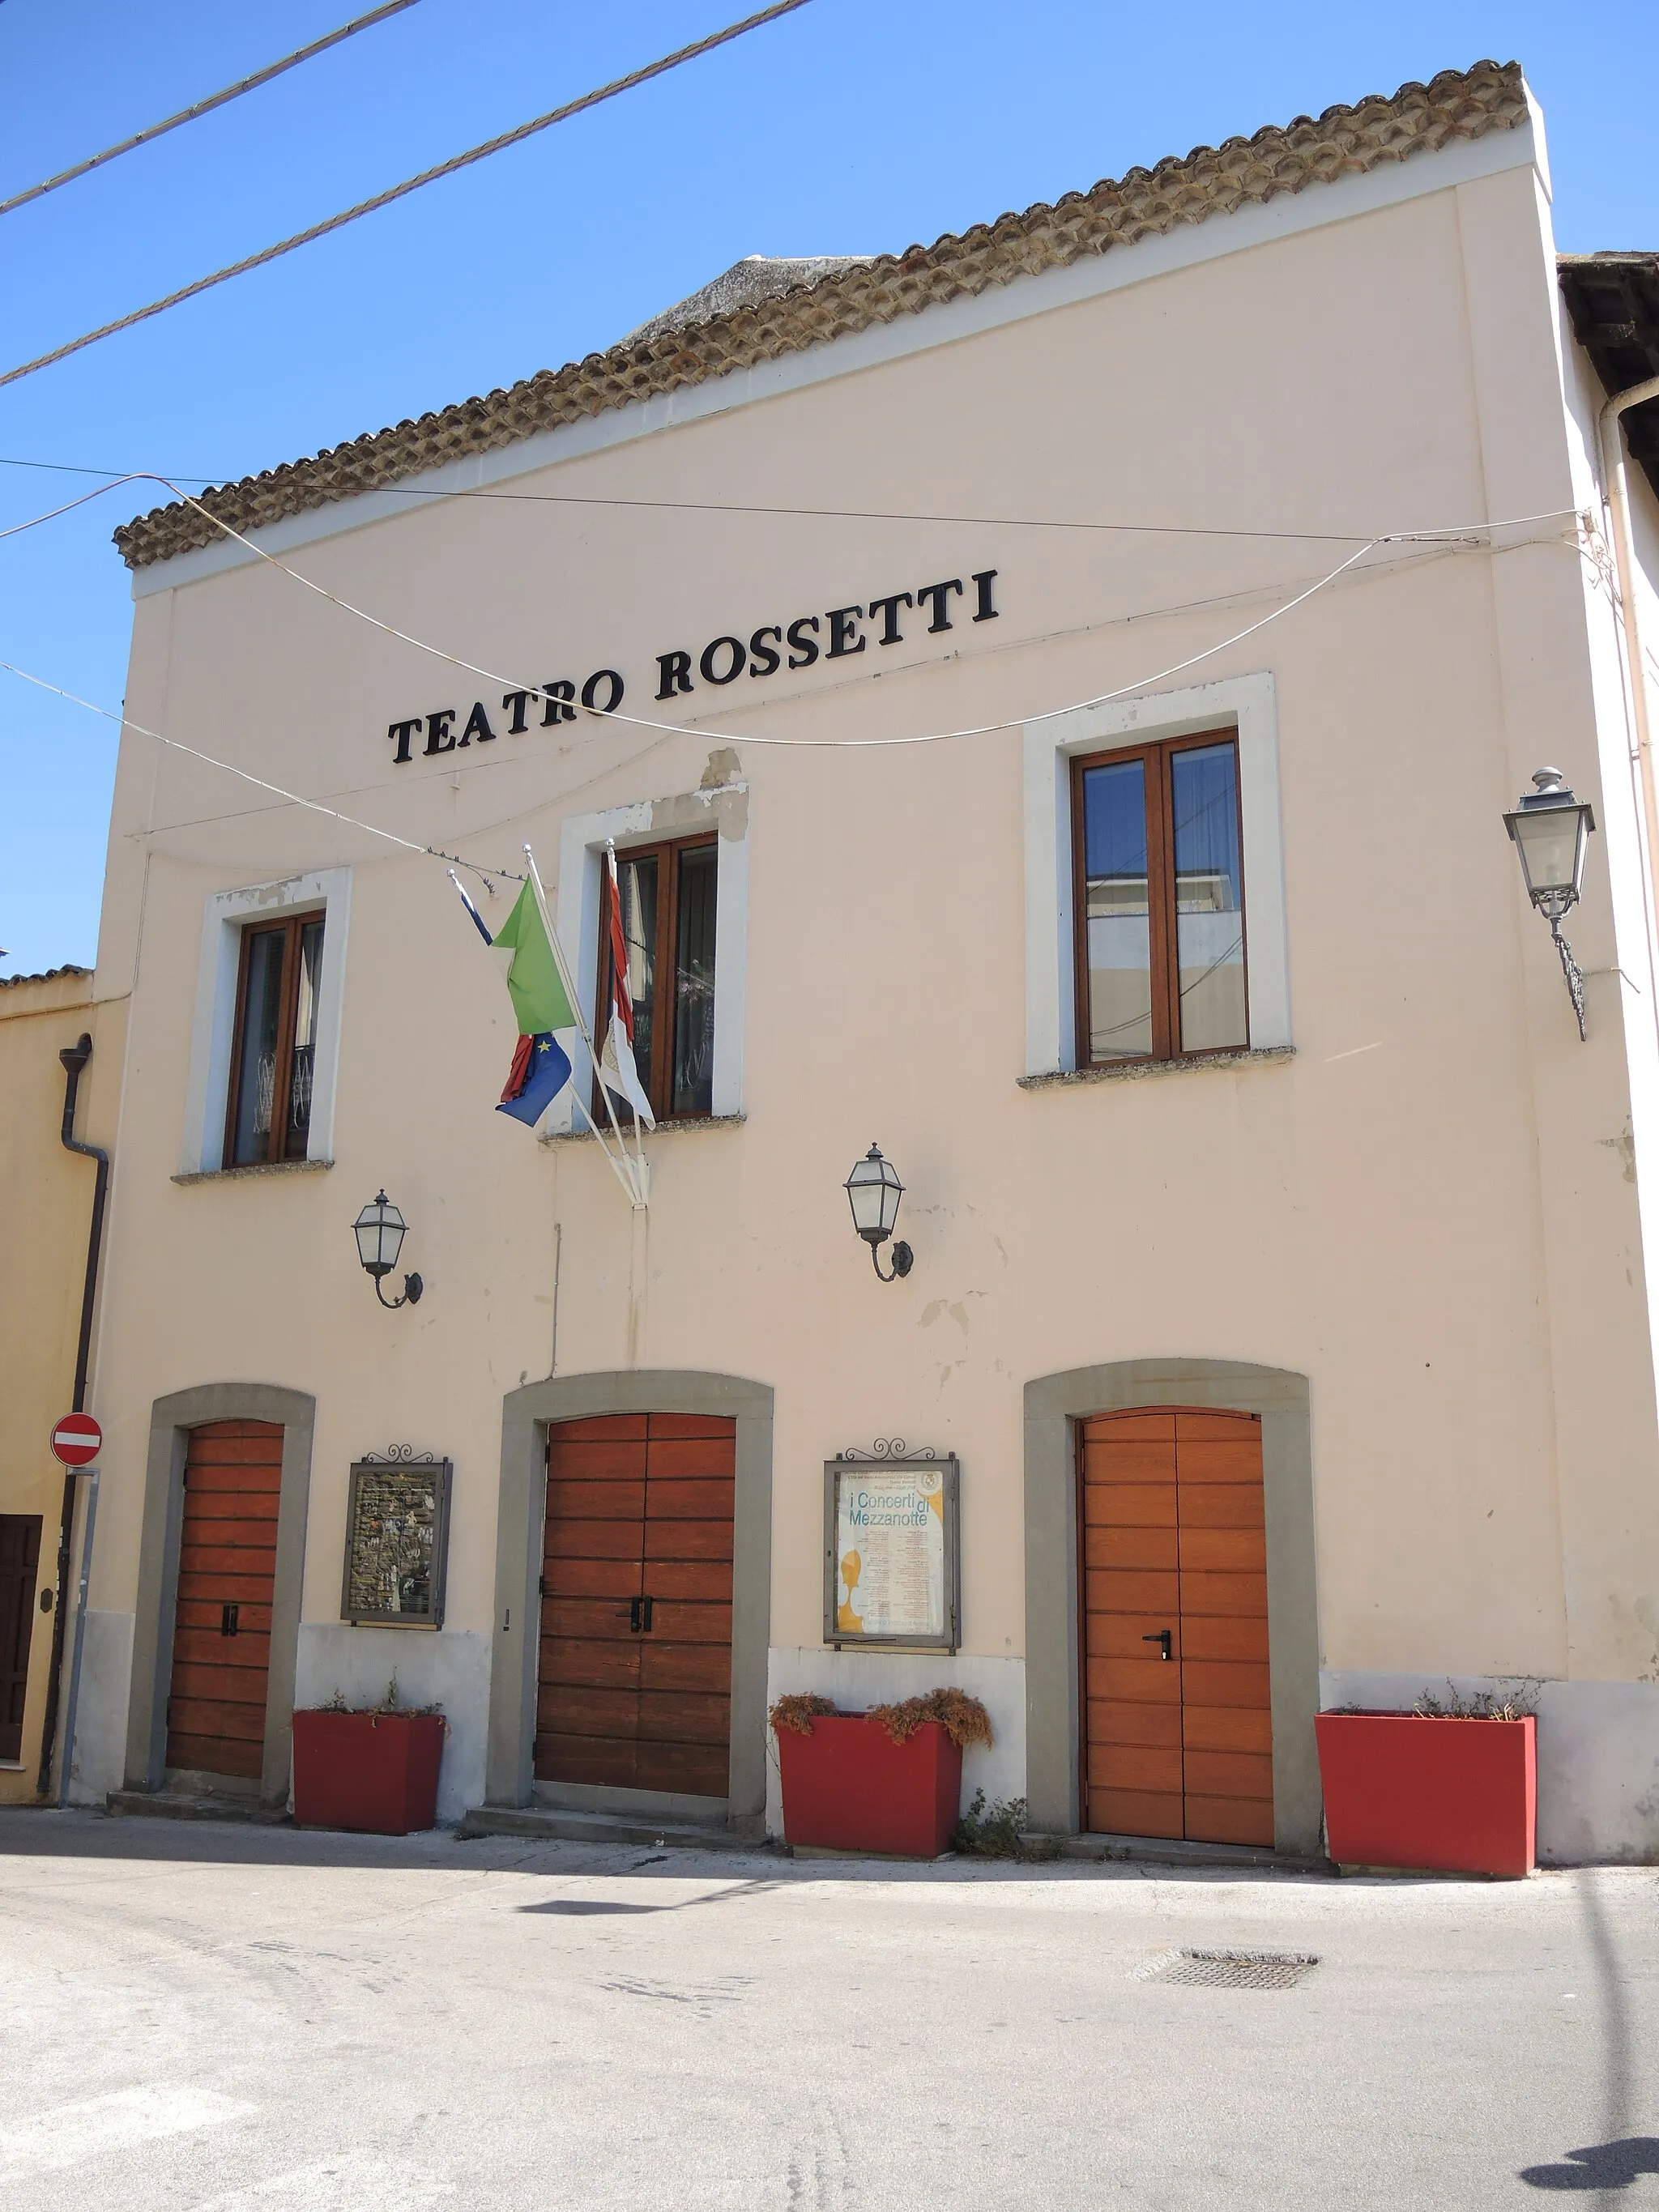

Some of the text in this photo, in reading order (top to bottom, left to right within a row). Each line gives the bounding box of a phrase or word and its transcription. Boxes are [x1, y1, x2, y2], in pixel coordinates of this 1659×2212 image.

[387, 569, 1000, 765] TEATRO ROSSETTI
[851, 1492, 930, 1513] i Concerti di
[849, 1510, 928, 1526] Mezzanotte
